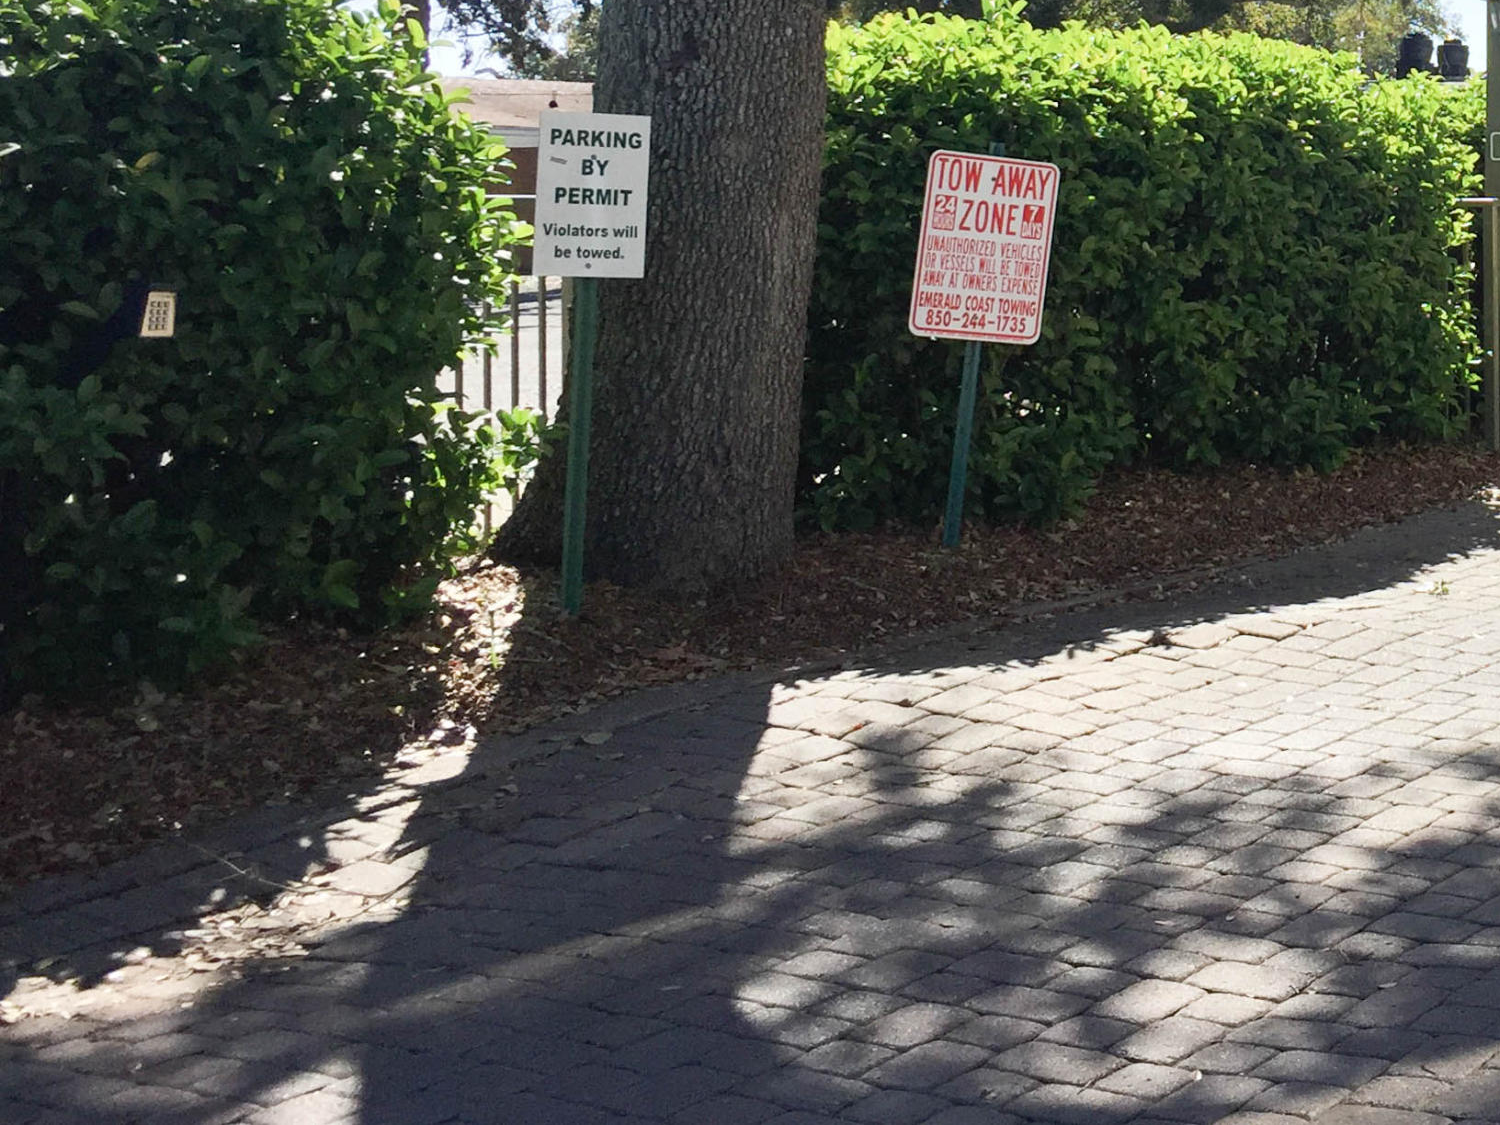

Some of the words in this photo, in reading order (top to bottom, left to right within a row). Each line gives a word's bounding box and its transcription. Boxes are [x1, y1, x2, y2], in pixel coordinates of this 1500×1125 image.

[550, 128, 642, 149] PARKING
[581, 159, 609, 176] BY
[938, 157, 983, 193] TOW
[991, 165, 1052, 201] AWAY
[554, 187, 632, 206] PERMIT
[935, 195, 956, 213] 24
[959, 199, 1019, 236] ZONE
[1028, 205, 1040, 222] 7
[543, 223, 608, 238] Violators
[613, 226, 638, 238] will
[1022, 222, 1042, 238] DAYS
[554, 245, 571, 258] be
[577, 246, 625, 259] towed.
[927, 235, 996, 257] UNAUTHORIZED
[1000, 243, 1042, 262] VEHICLES
[925, 252, 936, 268] OR
[940, 253, 975, 272] VESSELS
[979, 258, 996, 275] WILL
[1000, 260, 1010, 276] BE
[1014, 261, 1040, 279] TOWED
[923, 271, 946, 287] AWAY
[948, 273, 958, 288] AT
[962, 274, 997, 292] OWNERS
[1001, 277, 1038, 296] EXPENSE
[918, 291, 961, 310] EMERALD
[965, 295, 995, 313] COAST
[998, 298, 1036, 317] TOWING
[925, 309, 1026, 333] 850-244-1735
